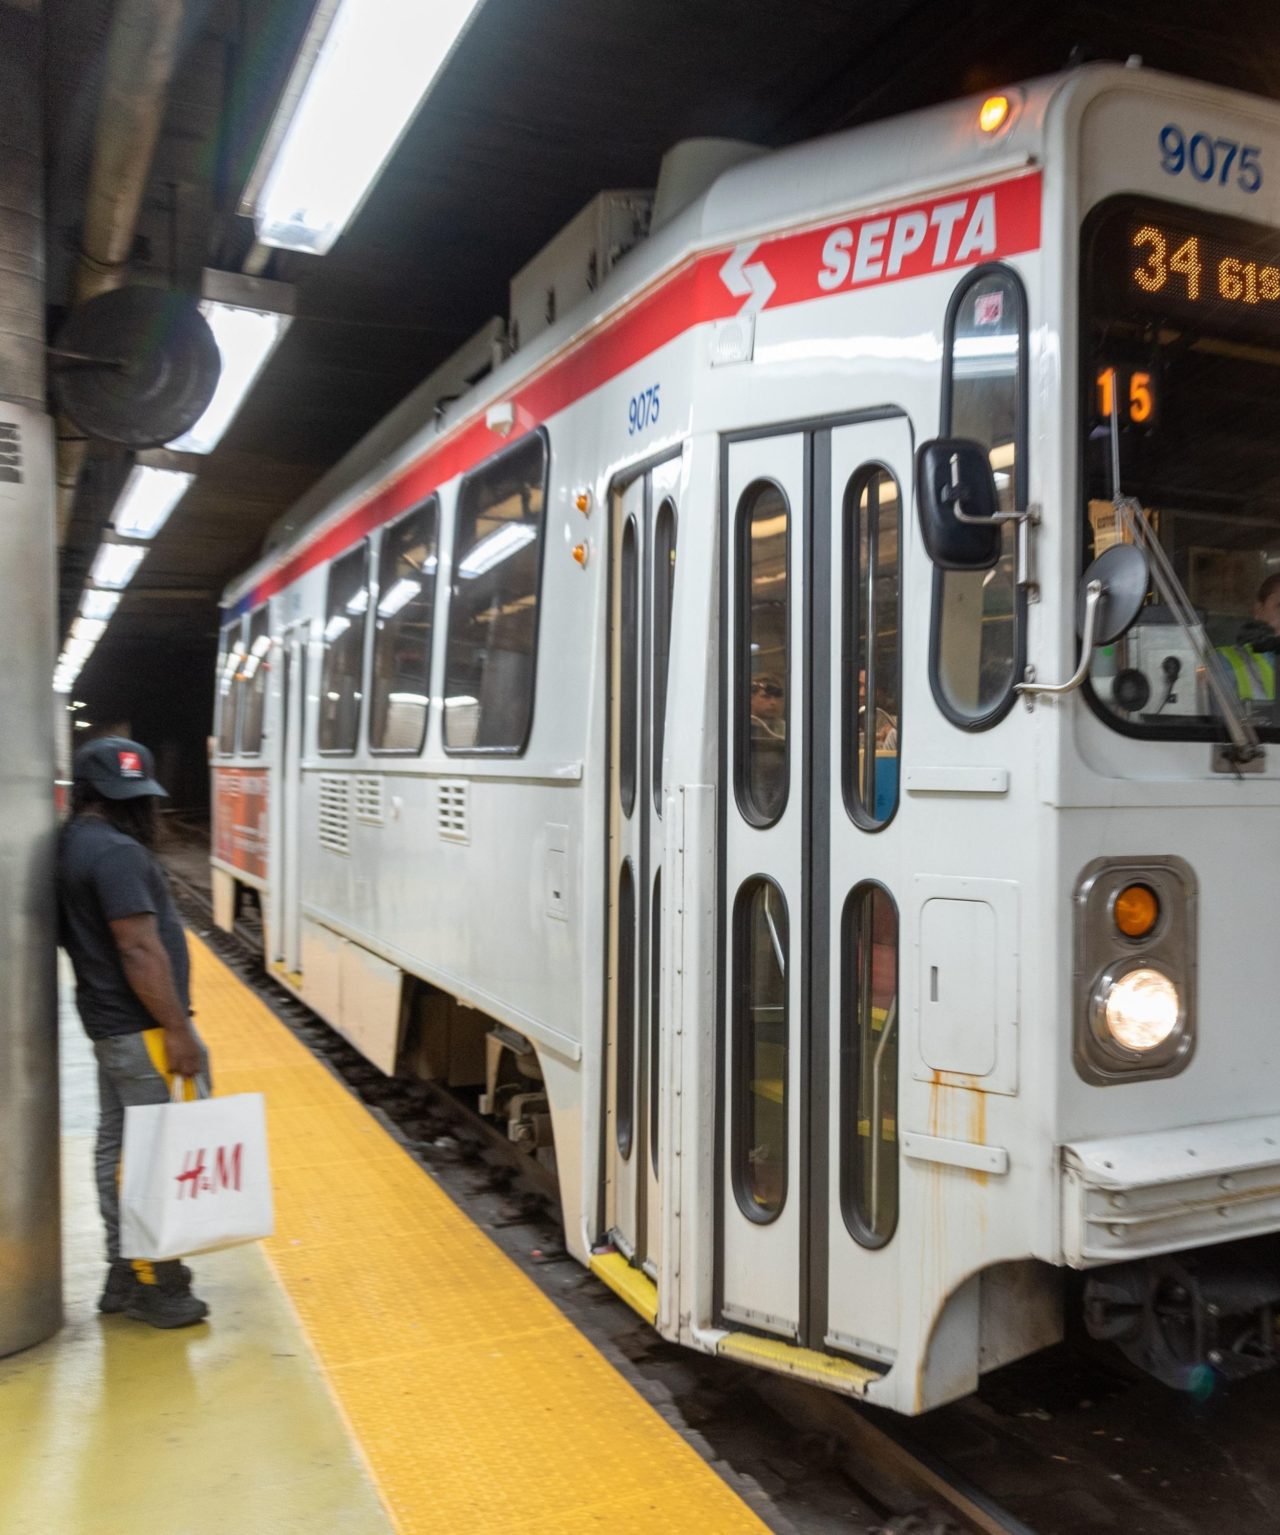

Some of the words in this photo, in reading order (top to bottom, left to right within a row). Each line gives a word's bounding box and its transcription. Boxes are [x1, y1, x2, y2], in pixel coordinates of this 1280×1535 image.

[1159, 122, 1264, 194] 9075
[817, 191, 998, 292] SEPTA
[1130, 225, 1202, 301] 34
[627, 383, 661, 437] 9075
[175, 1142, 243, 1201] H&M
